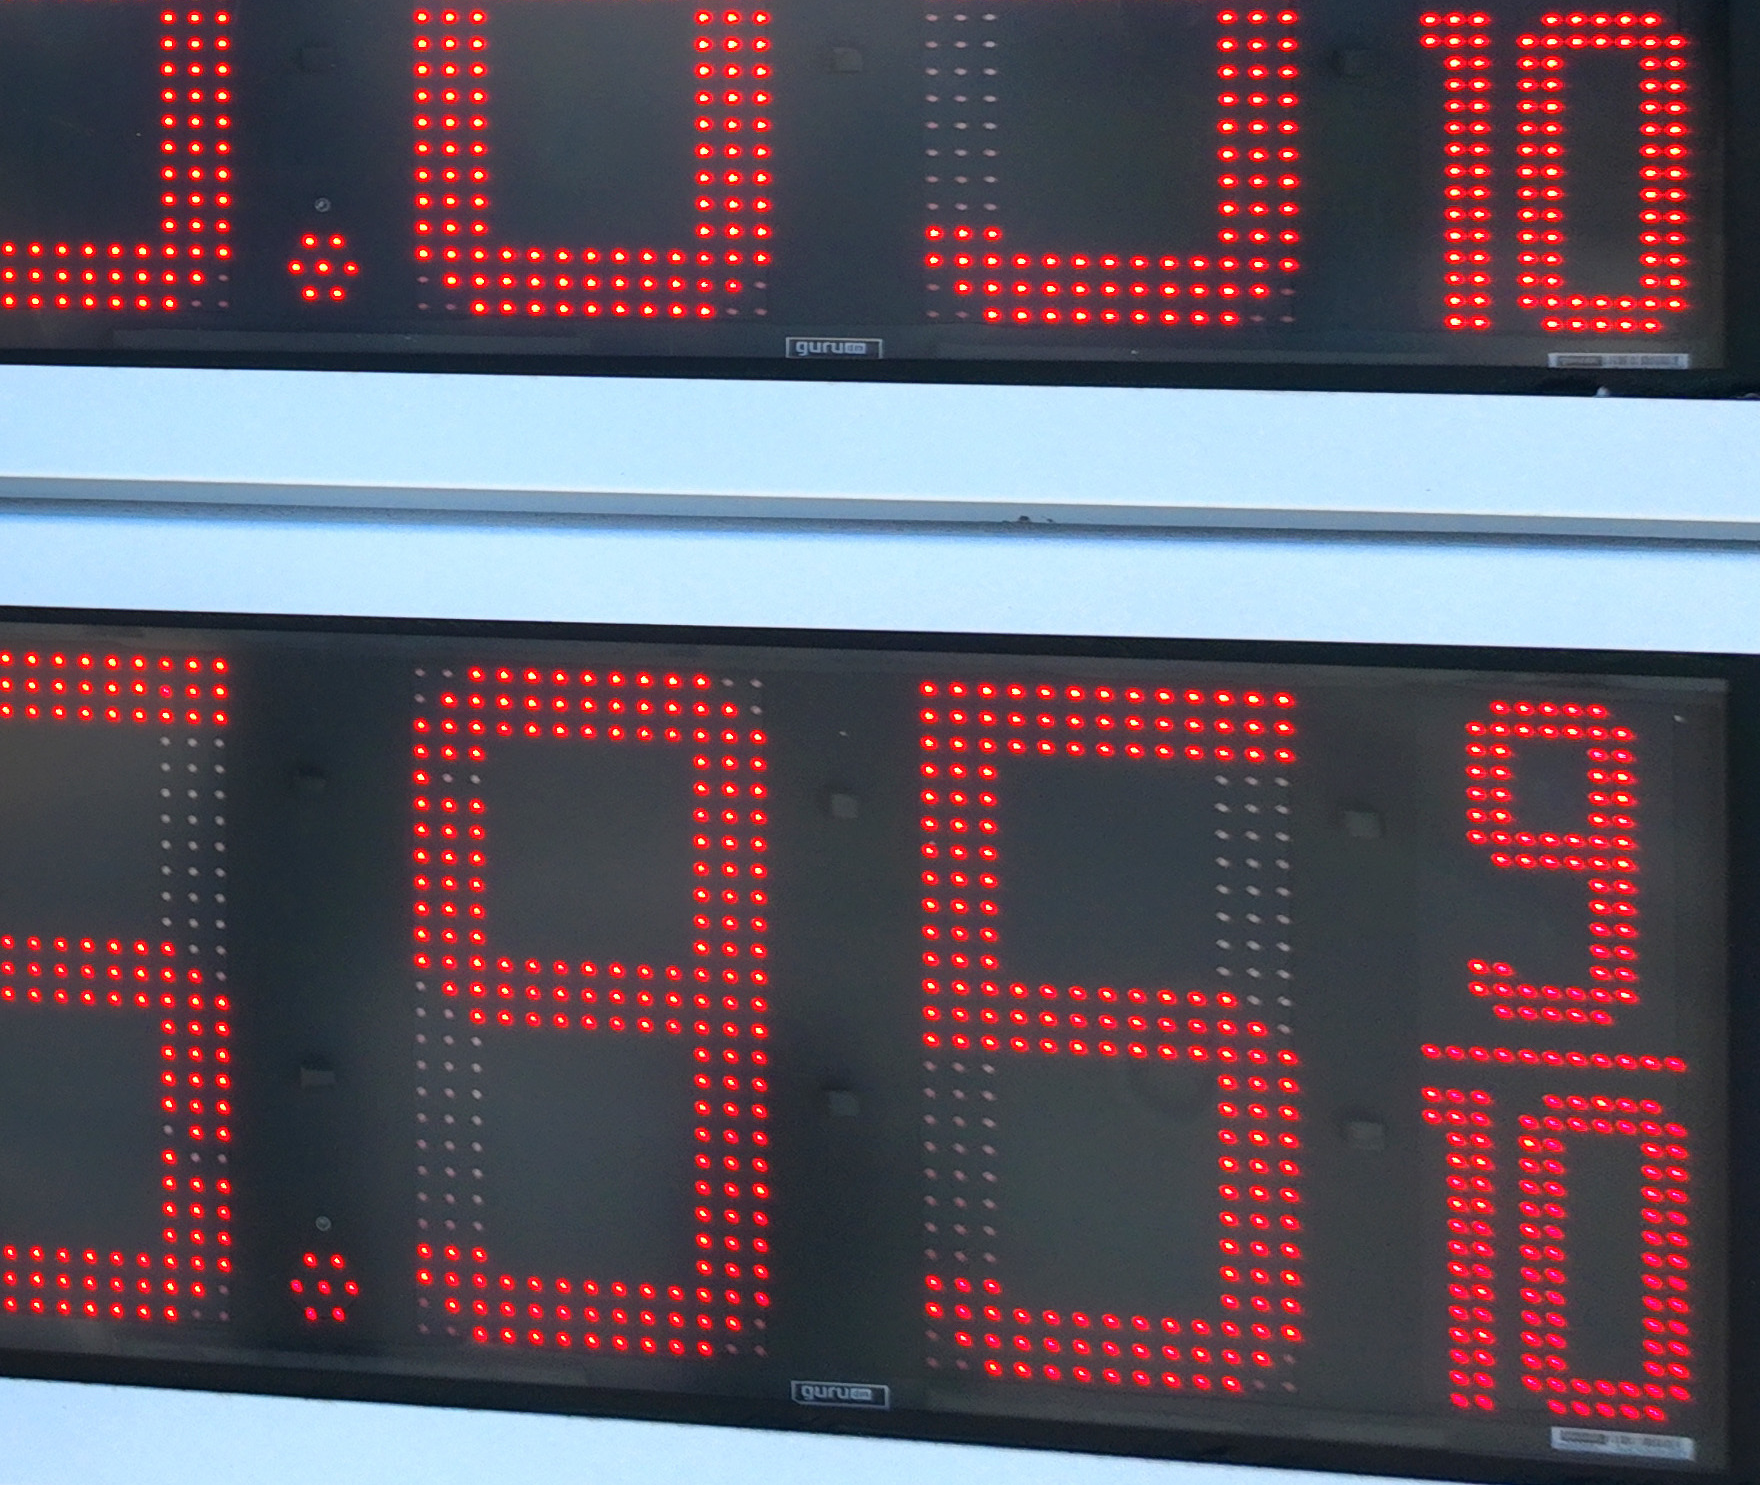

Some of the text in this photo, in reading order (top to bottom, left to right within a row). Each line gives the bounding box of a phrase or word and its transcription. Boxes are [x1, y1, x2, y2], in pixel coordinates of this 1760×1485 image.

[1419, 11, 1690, 333] 10
[1465, 701, 1640, 1025] 9
[1420, 1087, 1691, 1421] 10
